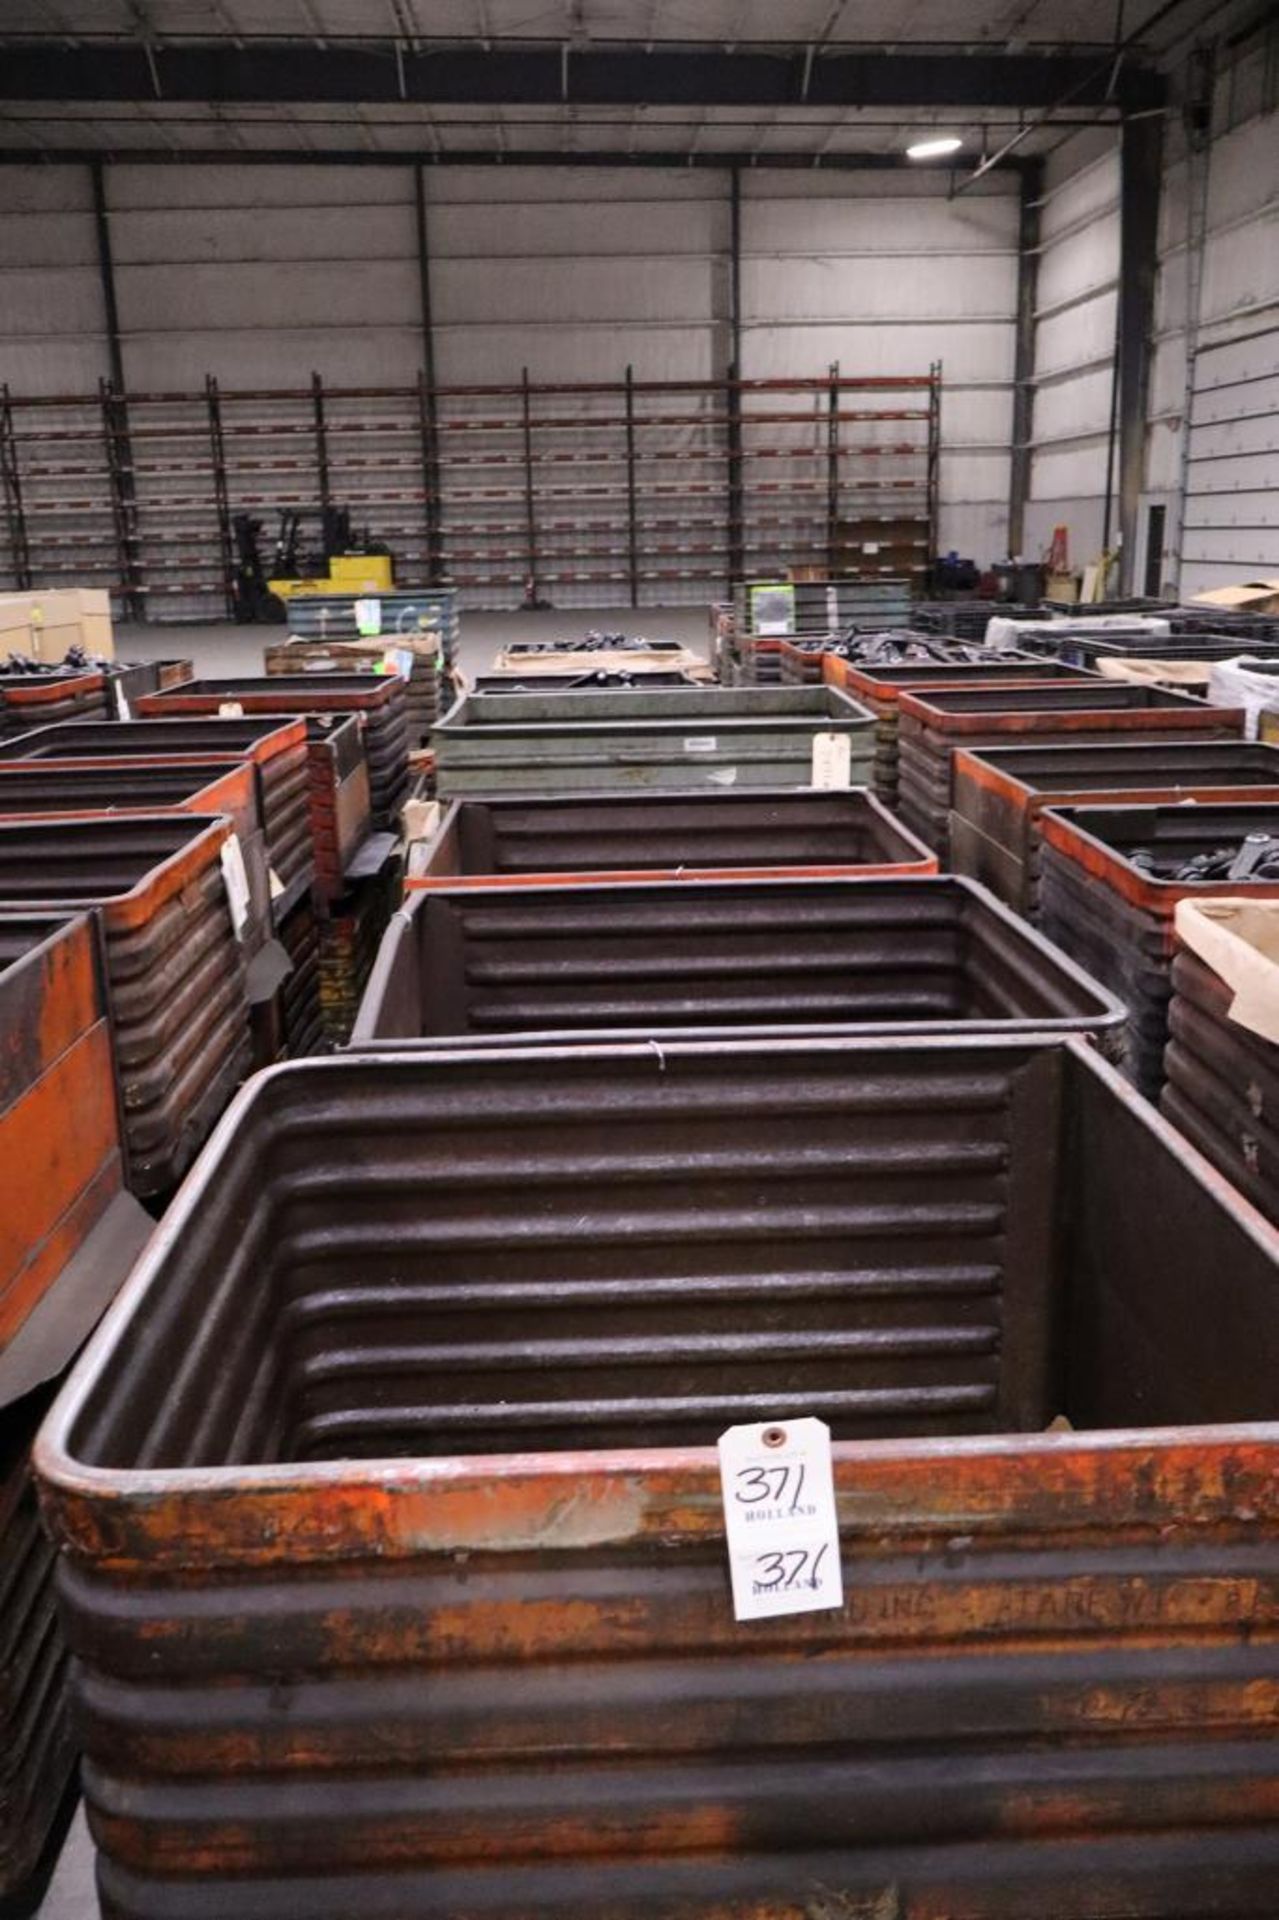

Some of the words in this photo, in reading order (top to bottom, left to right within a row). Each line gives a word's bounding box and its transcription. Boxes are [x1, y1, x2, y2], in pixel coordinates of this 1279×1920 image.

[735, 1463, 805, 1509] 371
[745, 1505, 817, 1522] HOLLAND
[753, 1543, 829, 1589] 371
